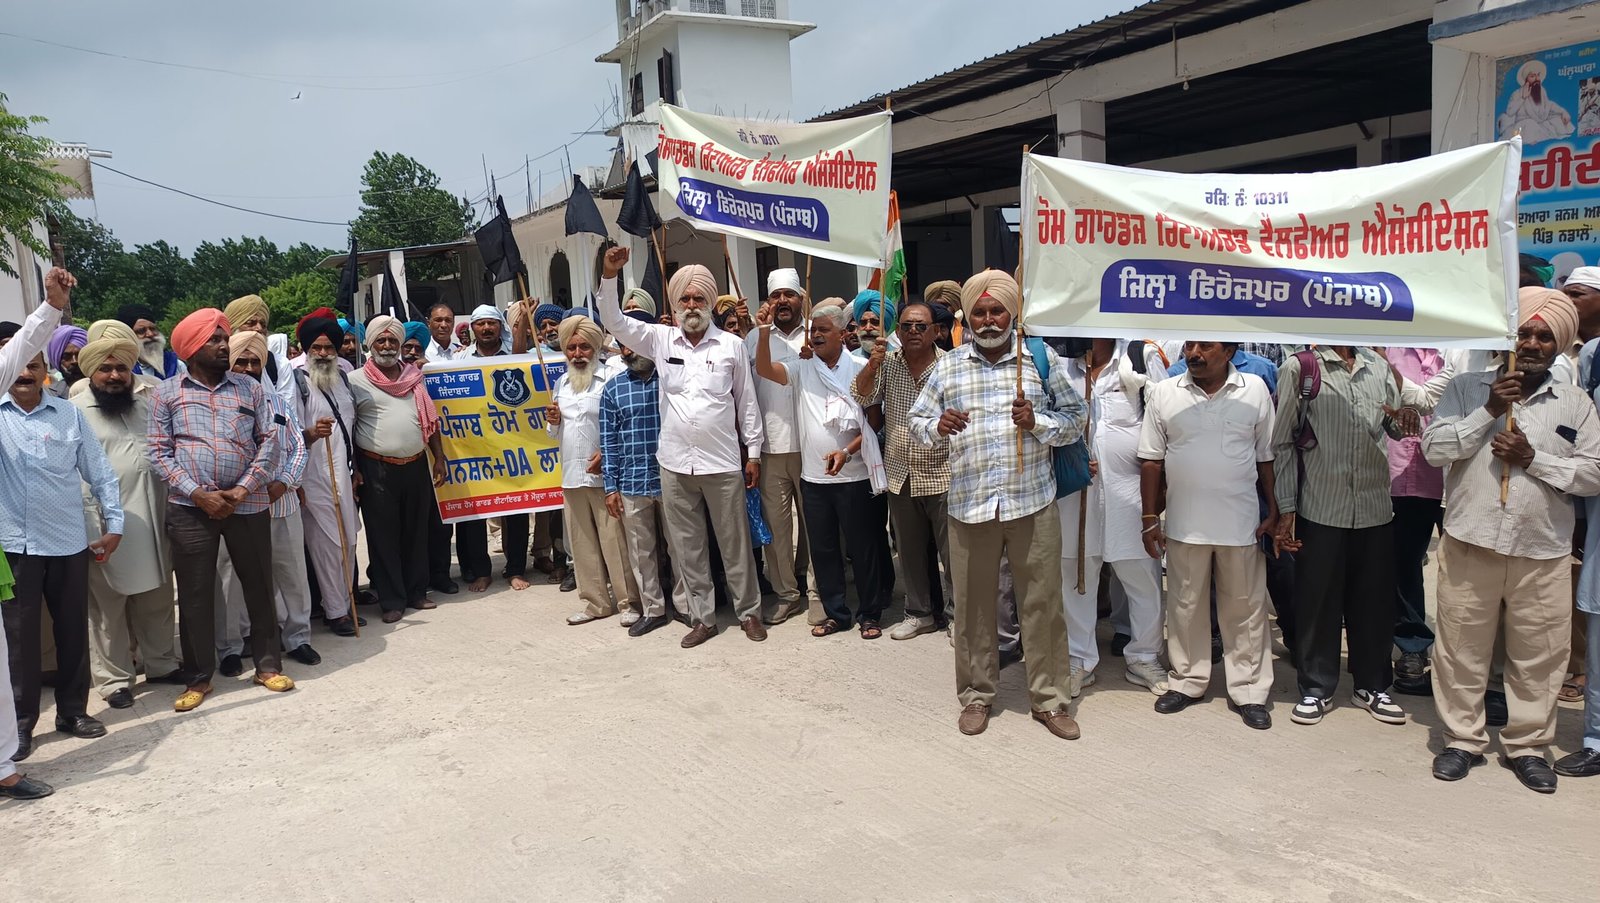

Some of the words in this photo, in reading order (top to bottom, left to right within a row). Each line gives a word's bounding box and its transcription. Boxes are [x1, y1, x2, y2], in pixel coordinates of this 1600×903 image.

[1254, 191, 1289, 206] 10311
[770, 200, 819, 232] (ਪੰਜਾਬ)
[1555, 207, 1579, 221] ਜਨਮ
[1038, 196, 1066, 245] ਹੋਮ
[1075, 209, 1147, 246] ਗਾਰਡਜ
[1259, 212, 1350, 259] ਵੈਲਫੇਅਰ
[1362, 199, 1489, 256] ਐਸੋਸੀਏਸ਼ਨ
[1532, 227, 1554, 245] ਪਿੰਡ
[1302, 276, 1394, 313] (ਪੰਜਾਬ)
[442, 372, 456, 384] ਹੋਮ
[458, 372, 480, 383] ਗਾਰਡ
[438, 405, 483, 438] ਪੰਜਾਬ
[487, 402, 520, 435] ਹੋਮ
